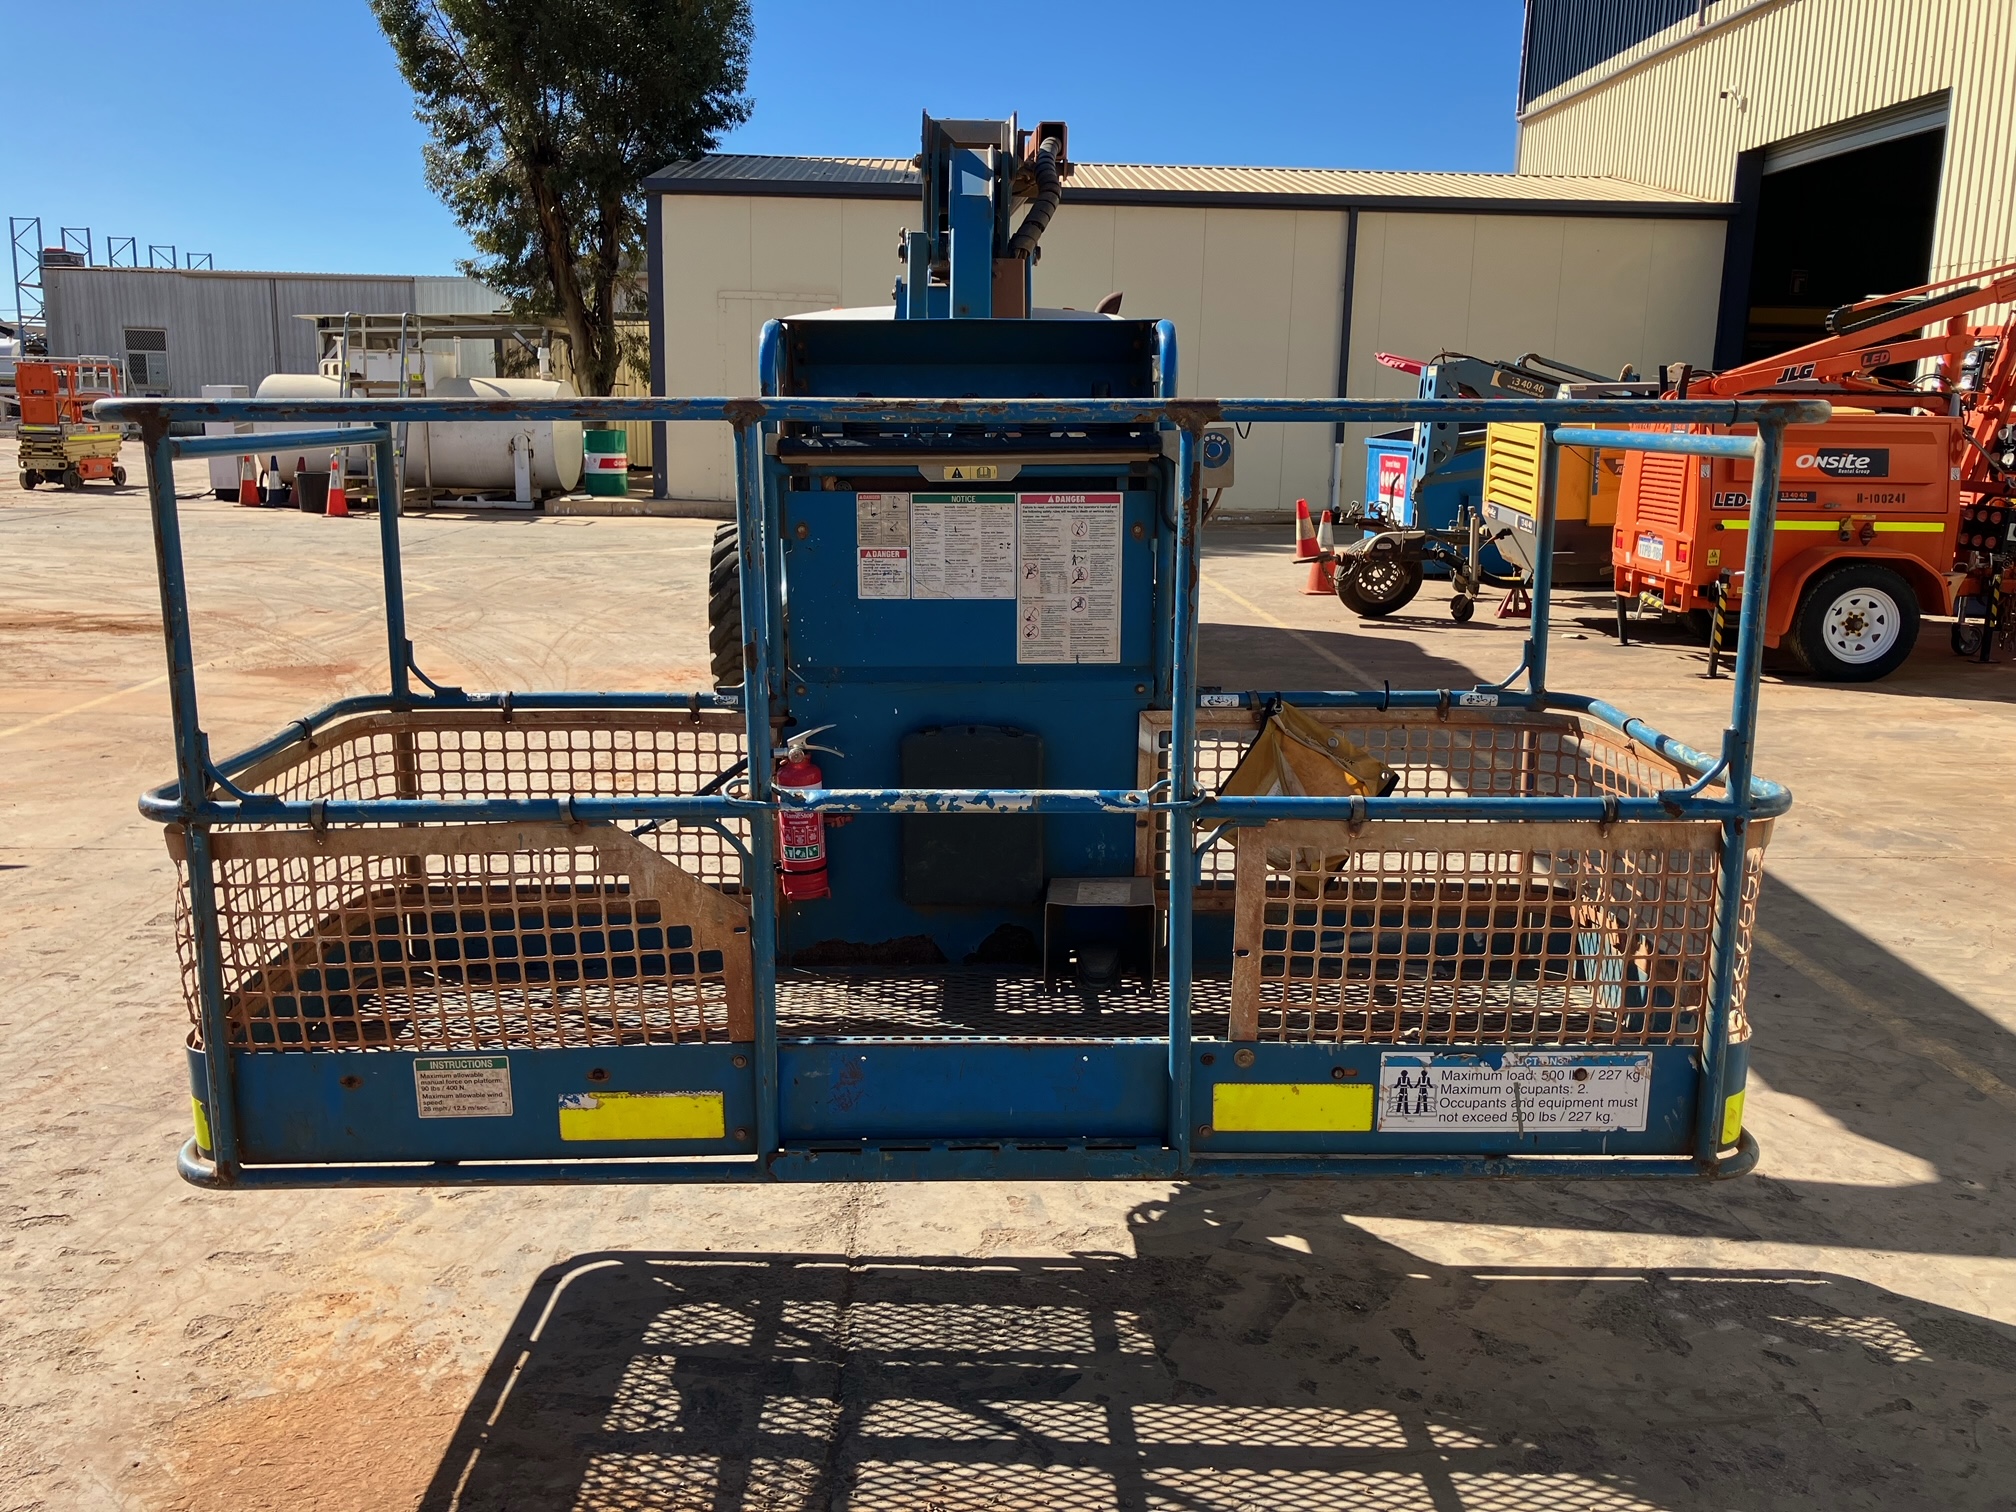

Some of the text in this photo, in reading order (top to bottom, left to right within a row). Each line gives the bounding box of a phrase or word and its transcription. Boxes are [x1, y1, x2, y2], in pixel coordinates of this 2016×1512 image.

[1862, 352, 1889, 366] LED
[1776, 363, 1815, 384] JLG
[1521, 380, 1532, 389] 40
[1533, 384, 1544, 393] 40
[430, 1060, 493, 1069] INSTRUCTIONS
[1442, 1070, 1502, 1080] Maximum
[1507, 1070, 1537, 1080] load:
[1541, 1070, 1564, 1080] 500
[1590, 1070, 1595, 1080] /
[1598, 1070, 1622, 1080] 227
[1626, 1070, 1644, 1082] kg.
[1441, 1084, 1501, 1094] Maximum
[1578, 1084, 1588, 1094] 2.
[1440, 1098, 1638, 1110] Occupants and equipment must
[1439, 1111, 1613, 1124] not exceed 500 lbs / 227 kg.
